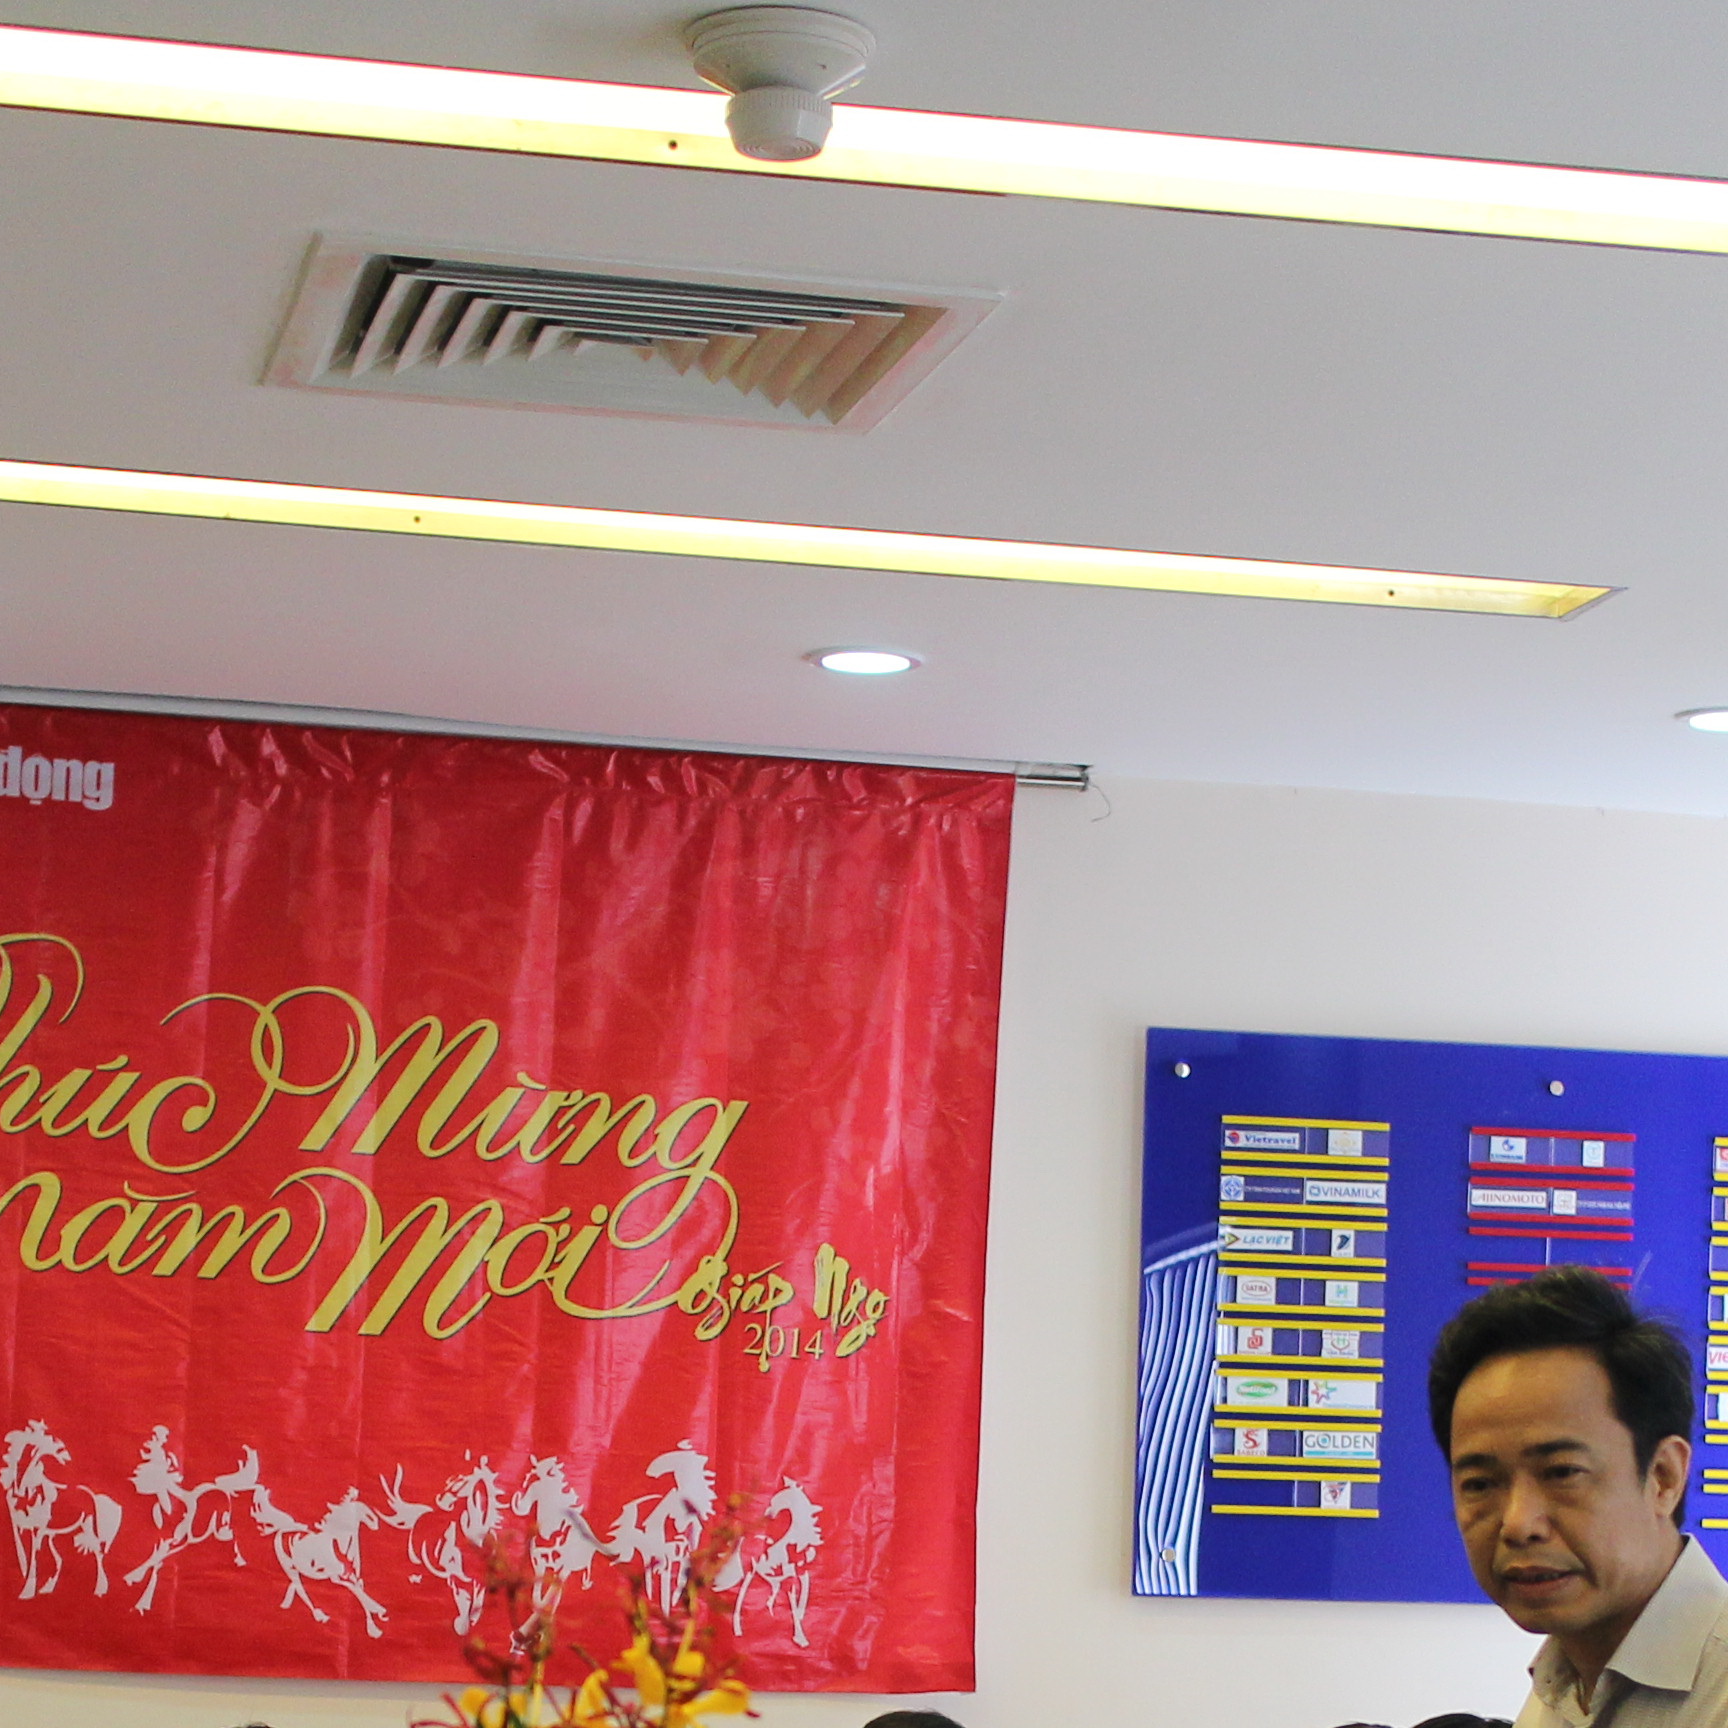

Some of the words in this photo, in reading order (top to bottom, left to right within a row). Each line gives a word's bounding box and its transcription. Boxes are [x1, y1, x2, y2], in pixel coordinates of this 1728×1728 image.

[251, 985, 749, 1249] Mừng
[1244, 1134, 1297, 1145] Vietravel
[1321, 1187, 1380, 1199] VINAMILK
[742, 1322, 825, 1361] 2014
[1304, 1433, 1375, 1449] GOLDEN
